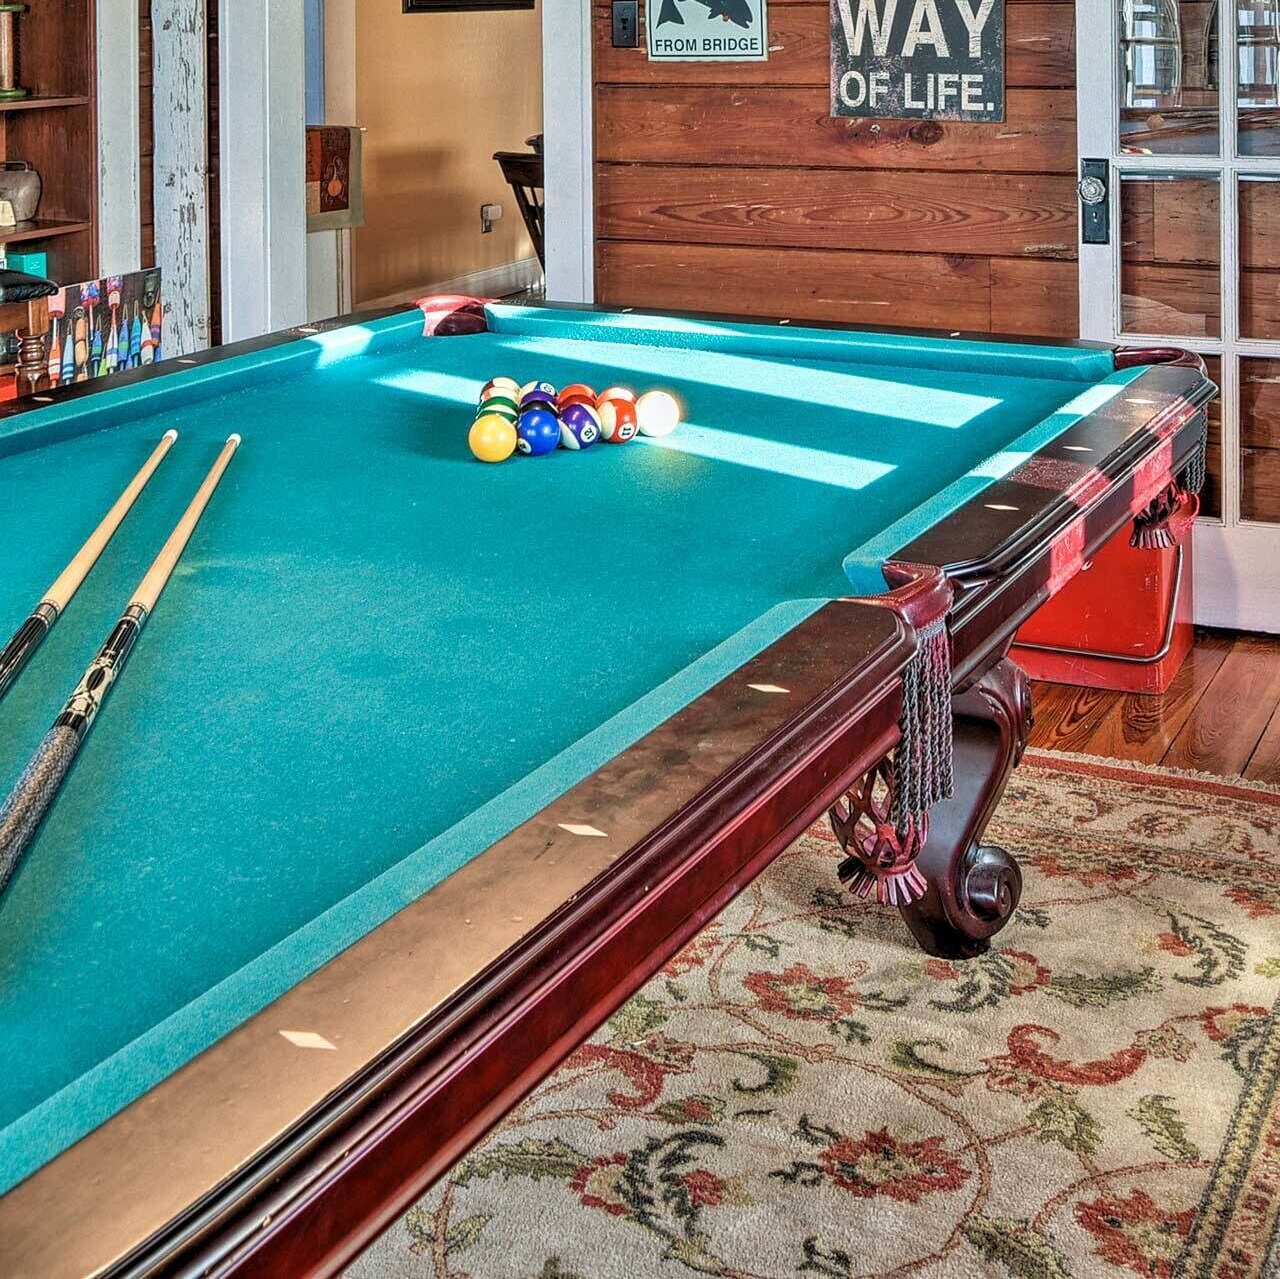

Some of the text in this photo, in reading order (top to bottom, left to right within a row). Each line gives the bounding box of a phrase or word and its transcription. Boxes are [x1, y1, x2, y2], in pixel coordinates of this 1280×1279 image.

[655, 37, 759, 52] FROM BRIDGE
[839, 70, 995, 111] OF LIFE.
[584, 427, 595, 440] 12
[622, 427, 632, 437] 11
